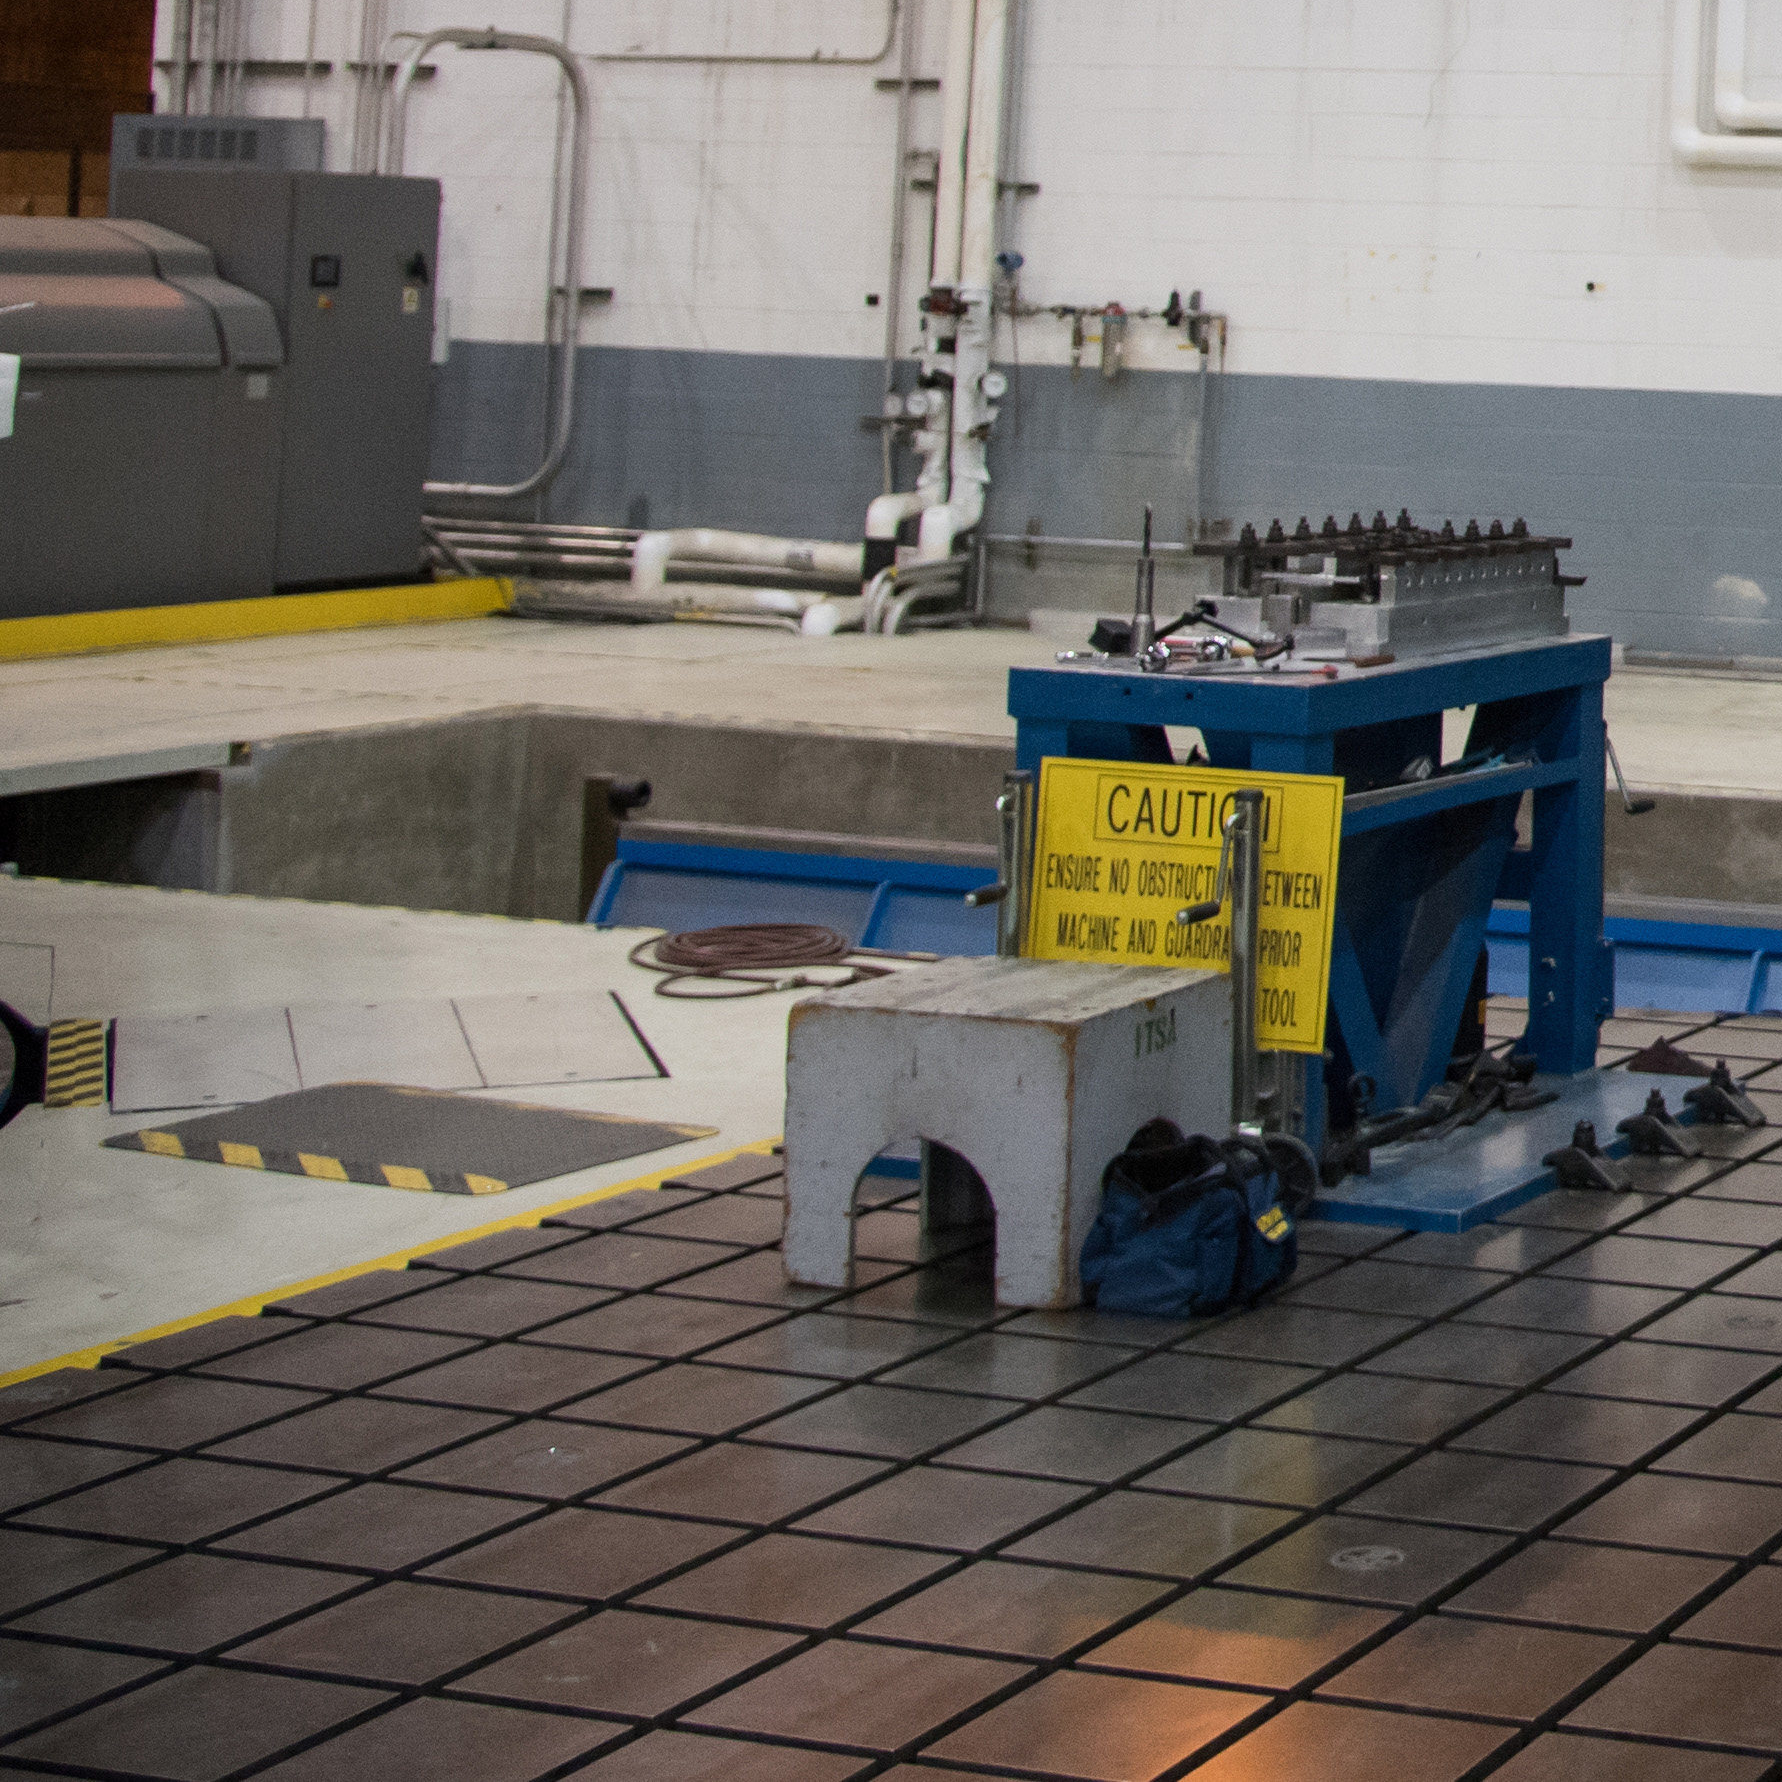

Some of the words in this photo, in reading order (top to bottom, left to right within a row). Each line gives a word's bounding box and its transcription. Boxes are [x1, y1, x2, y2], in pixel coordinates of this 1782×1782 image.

[1046, 853, 1102, 893] ENSURE
[1108, 857, 1130, 896] NO
[1262, 869, 1323, 910] ETWEEN
[1056, 911, 1120, 953] MACHINE
[1126, 915, 1157, 956] AND
[1164, 919, 1231, 962] GUARDRA
[1258, 928, 1301, 967] PRIOR
[1261, 987, 1297, 1028] TOOL
